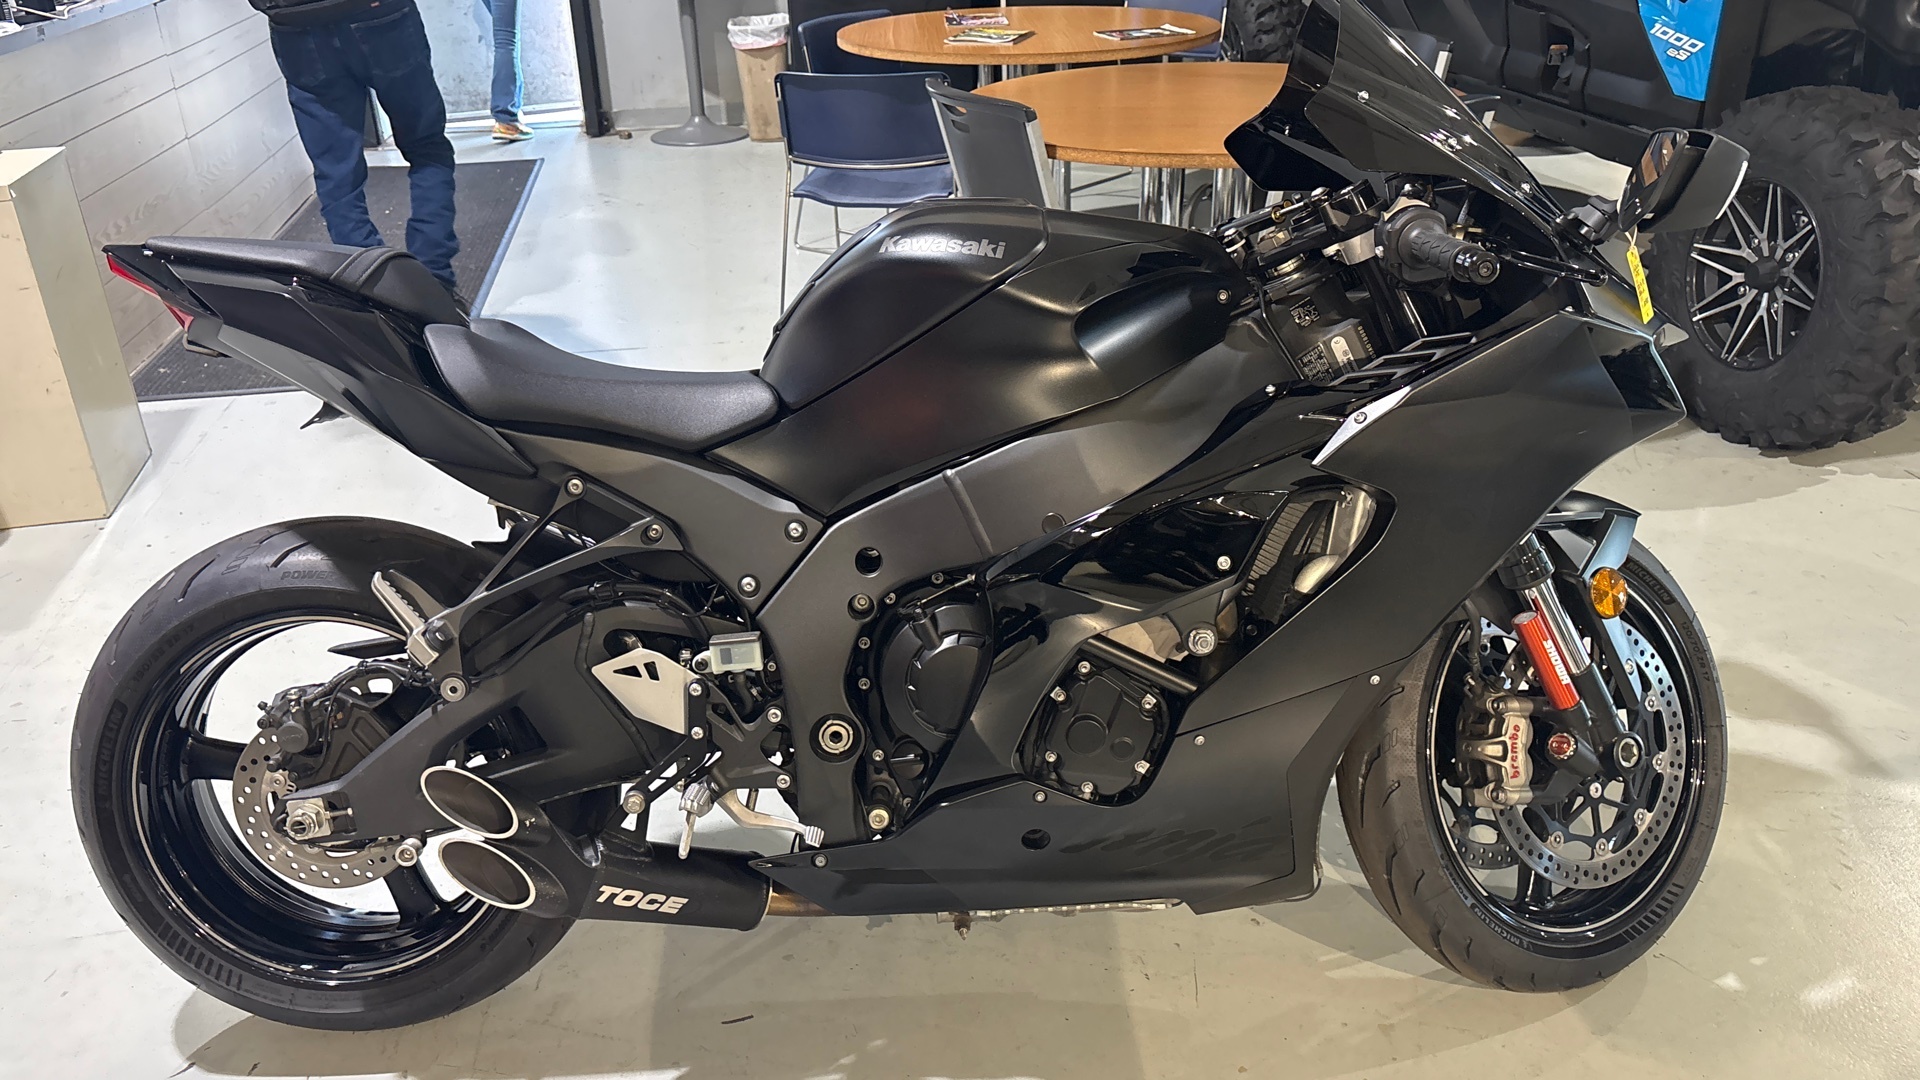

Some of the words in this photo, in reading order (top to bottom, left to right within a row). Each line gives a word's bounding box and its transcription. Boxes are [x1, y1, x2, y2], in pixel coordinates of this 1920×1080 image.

[1649, 22, 1706, 53] 1000
[878, 235, 1007, 259] Kawasaki
[280, 570, 336, 581] POWER
[1626, 561, 1672, 602] MICHELIN
[1543, 639, 1571, 685] SHOWA
[1508, 724, 1521, 780] brembo
[596, 885, 689, 915] TOCE
[1474, 907, 1521, 945] MICHELIN
